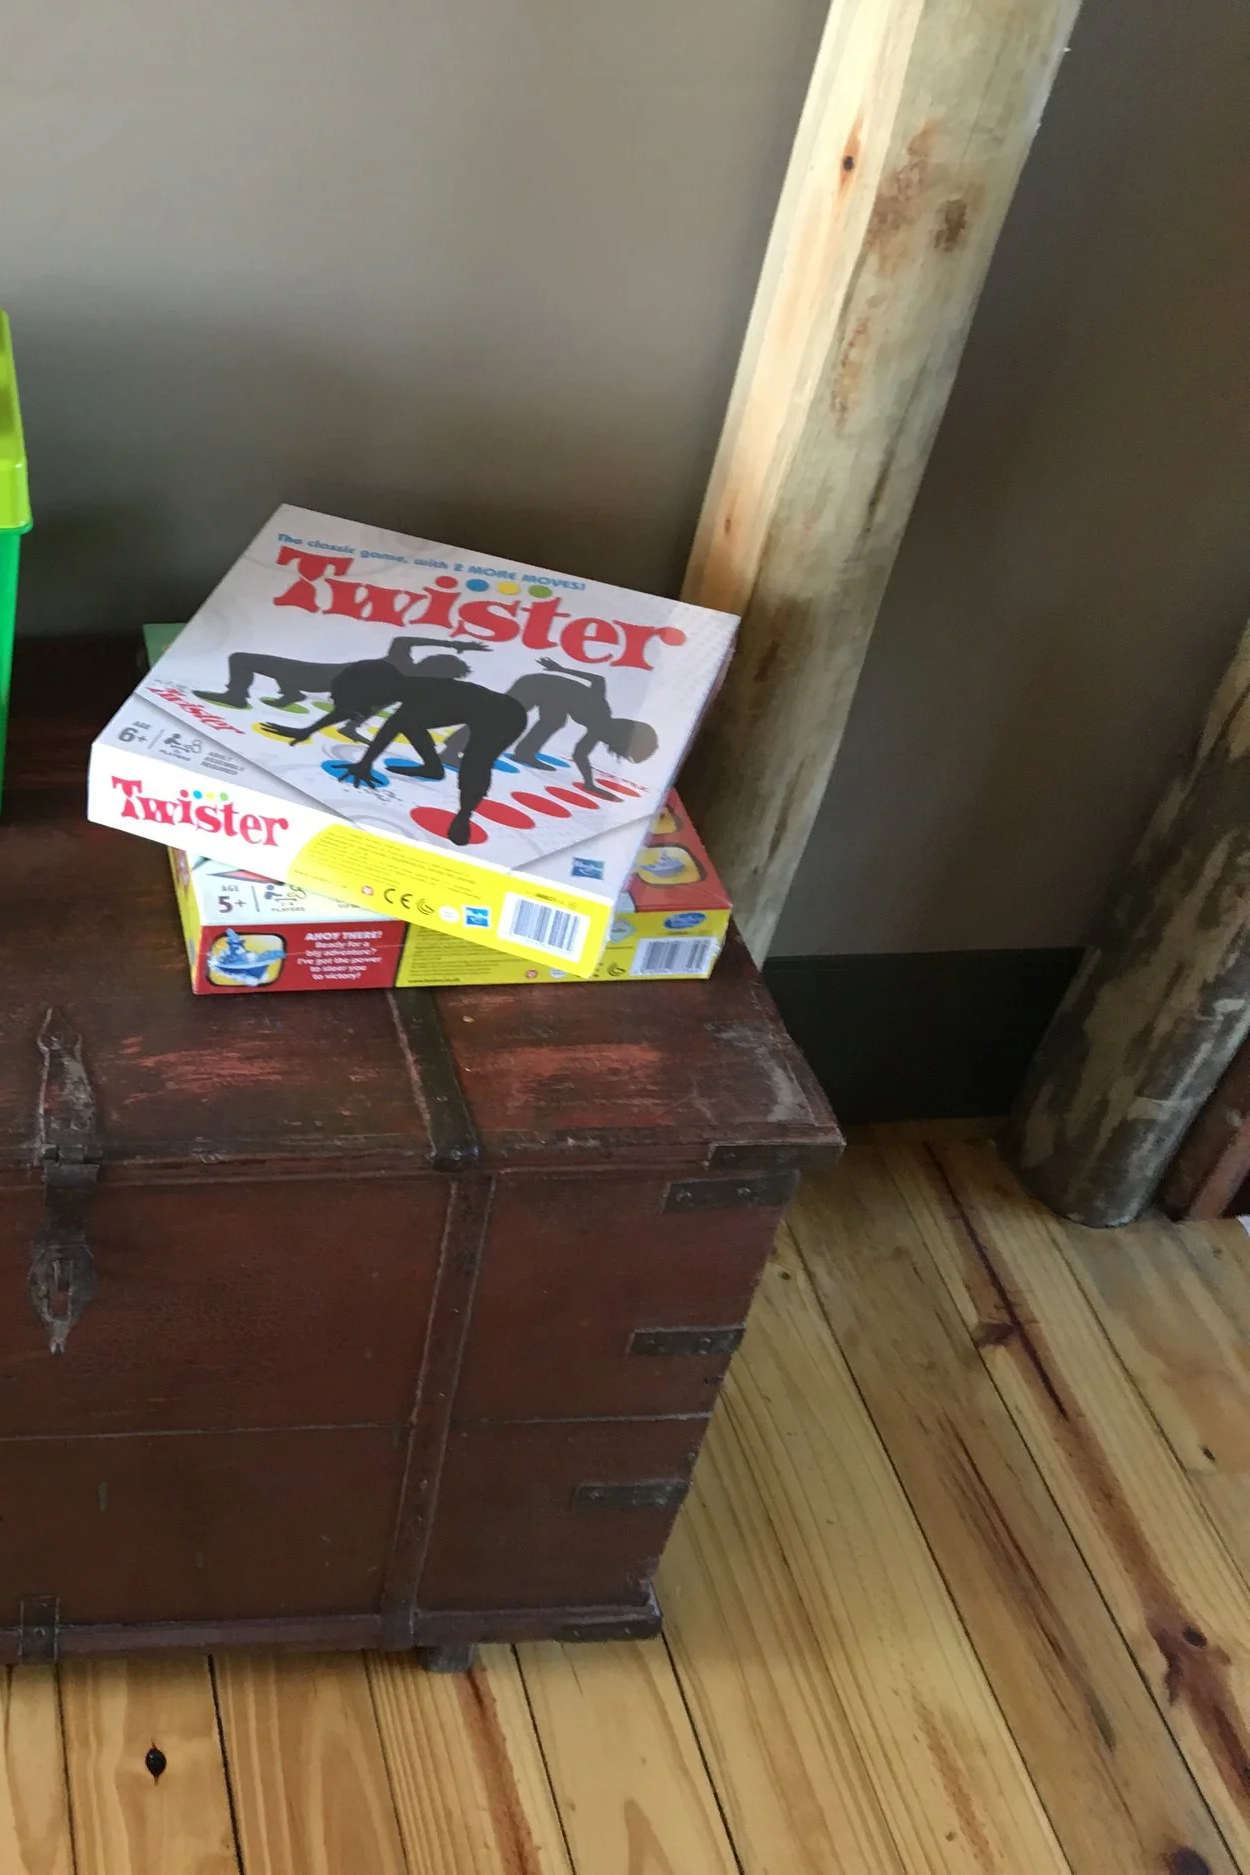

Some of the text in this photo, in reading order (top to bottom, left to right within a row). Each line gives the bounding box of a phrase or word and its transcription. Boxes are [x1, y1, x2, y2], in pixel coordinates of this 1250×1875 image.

[277, 532, 586, 591] The classic game, with 2 MORE MOVES!
[273, 545, 686, 671] Twister
[118, 726, 148, 744] 6+
[110, 775, 289, 847] Twister
[221, 884, 240, 893] AGE
[217, 895, 247, 913] 5+
[304, 930, 383, 942] AHOY THERE!
[315, 941, 347, 949] Ready
[304, 950, 322, 958] big
[315, 958, 333, 966] got
[333, 957, 351, 965] the
[350, 957, 383, 965] power
[322, 965, 347, 973] steer
[348, 965, 367, 973] you
